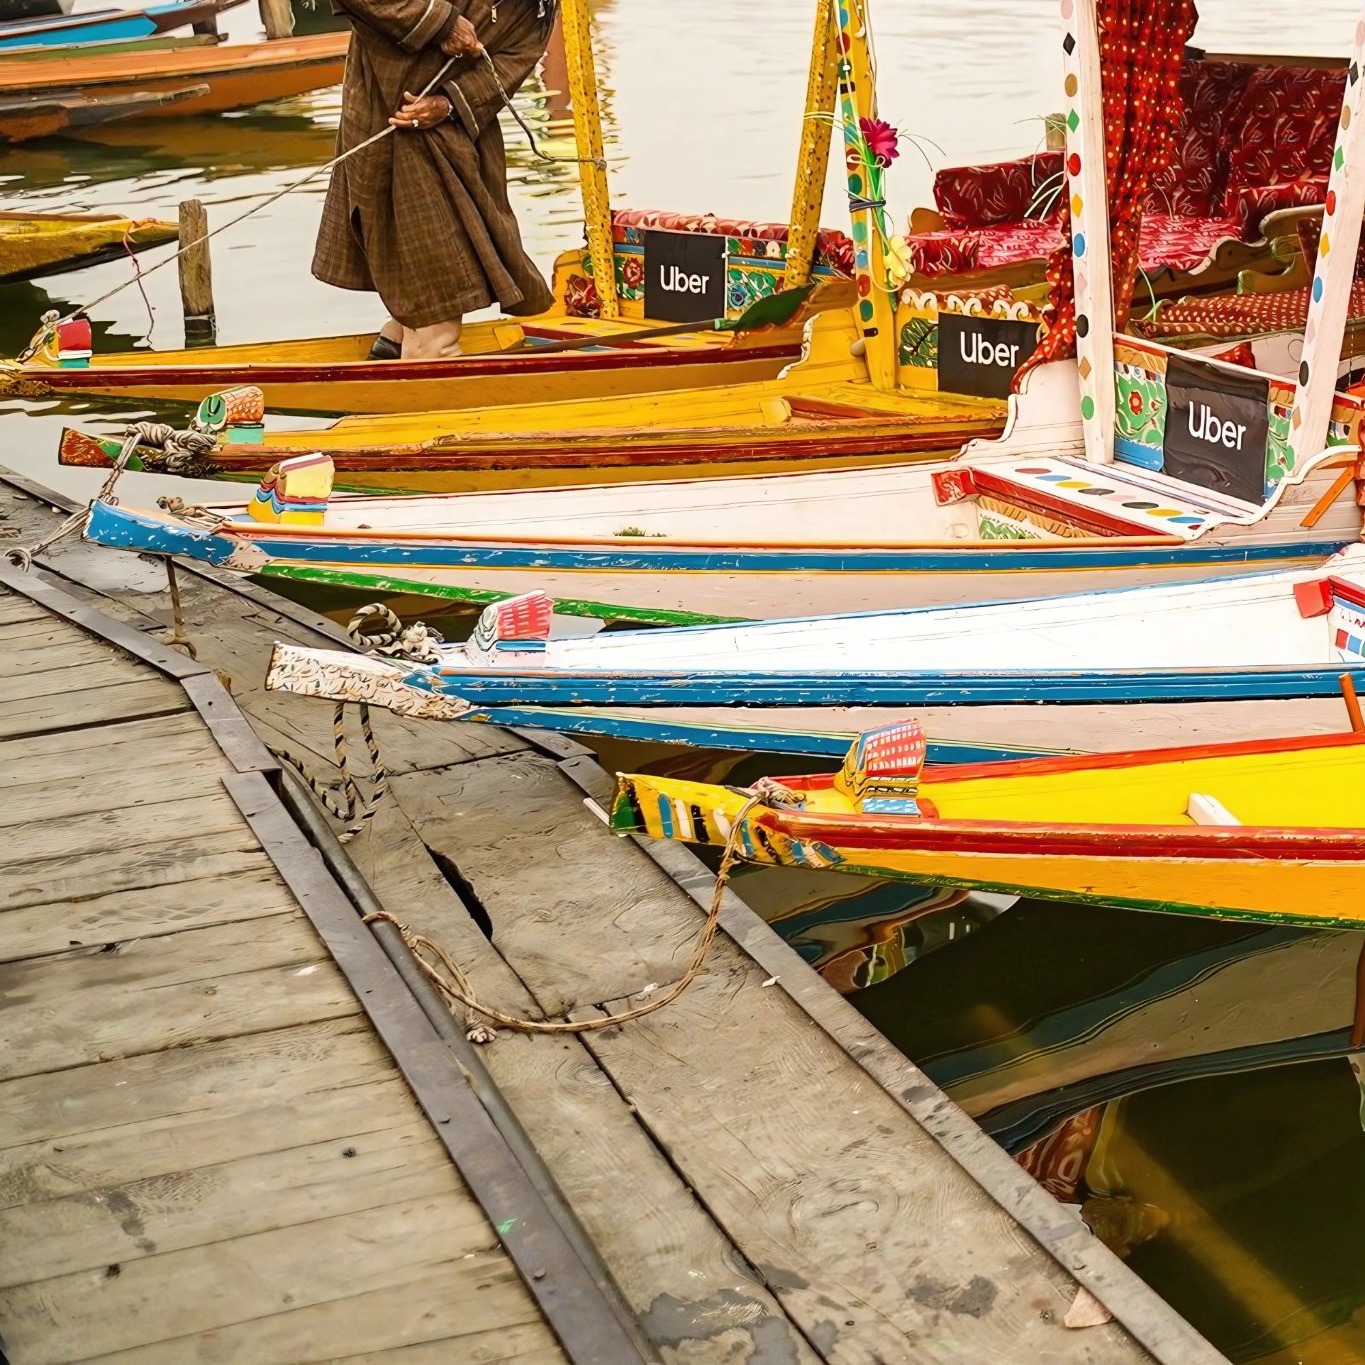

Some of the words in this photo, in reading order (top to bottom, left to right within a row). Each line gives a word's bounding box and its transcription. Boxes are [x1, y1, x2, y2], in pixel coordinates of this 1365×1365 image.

[660, 264, 710, 294] Uber
[960, 331, 1020, 368] Uber
[1188, 400, 1247, 451] Uber
